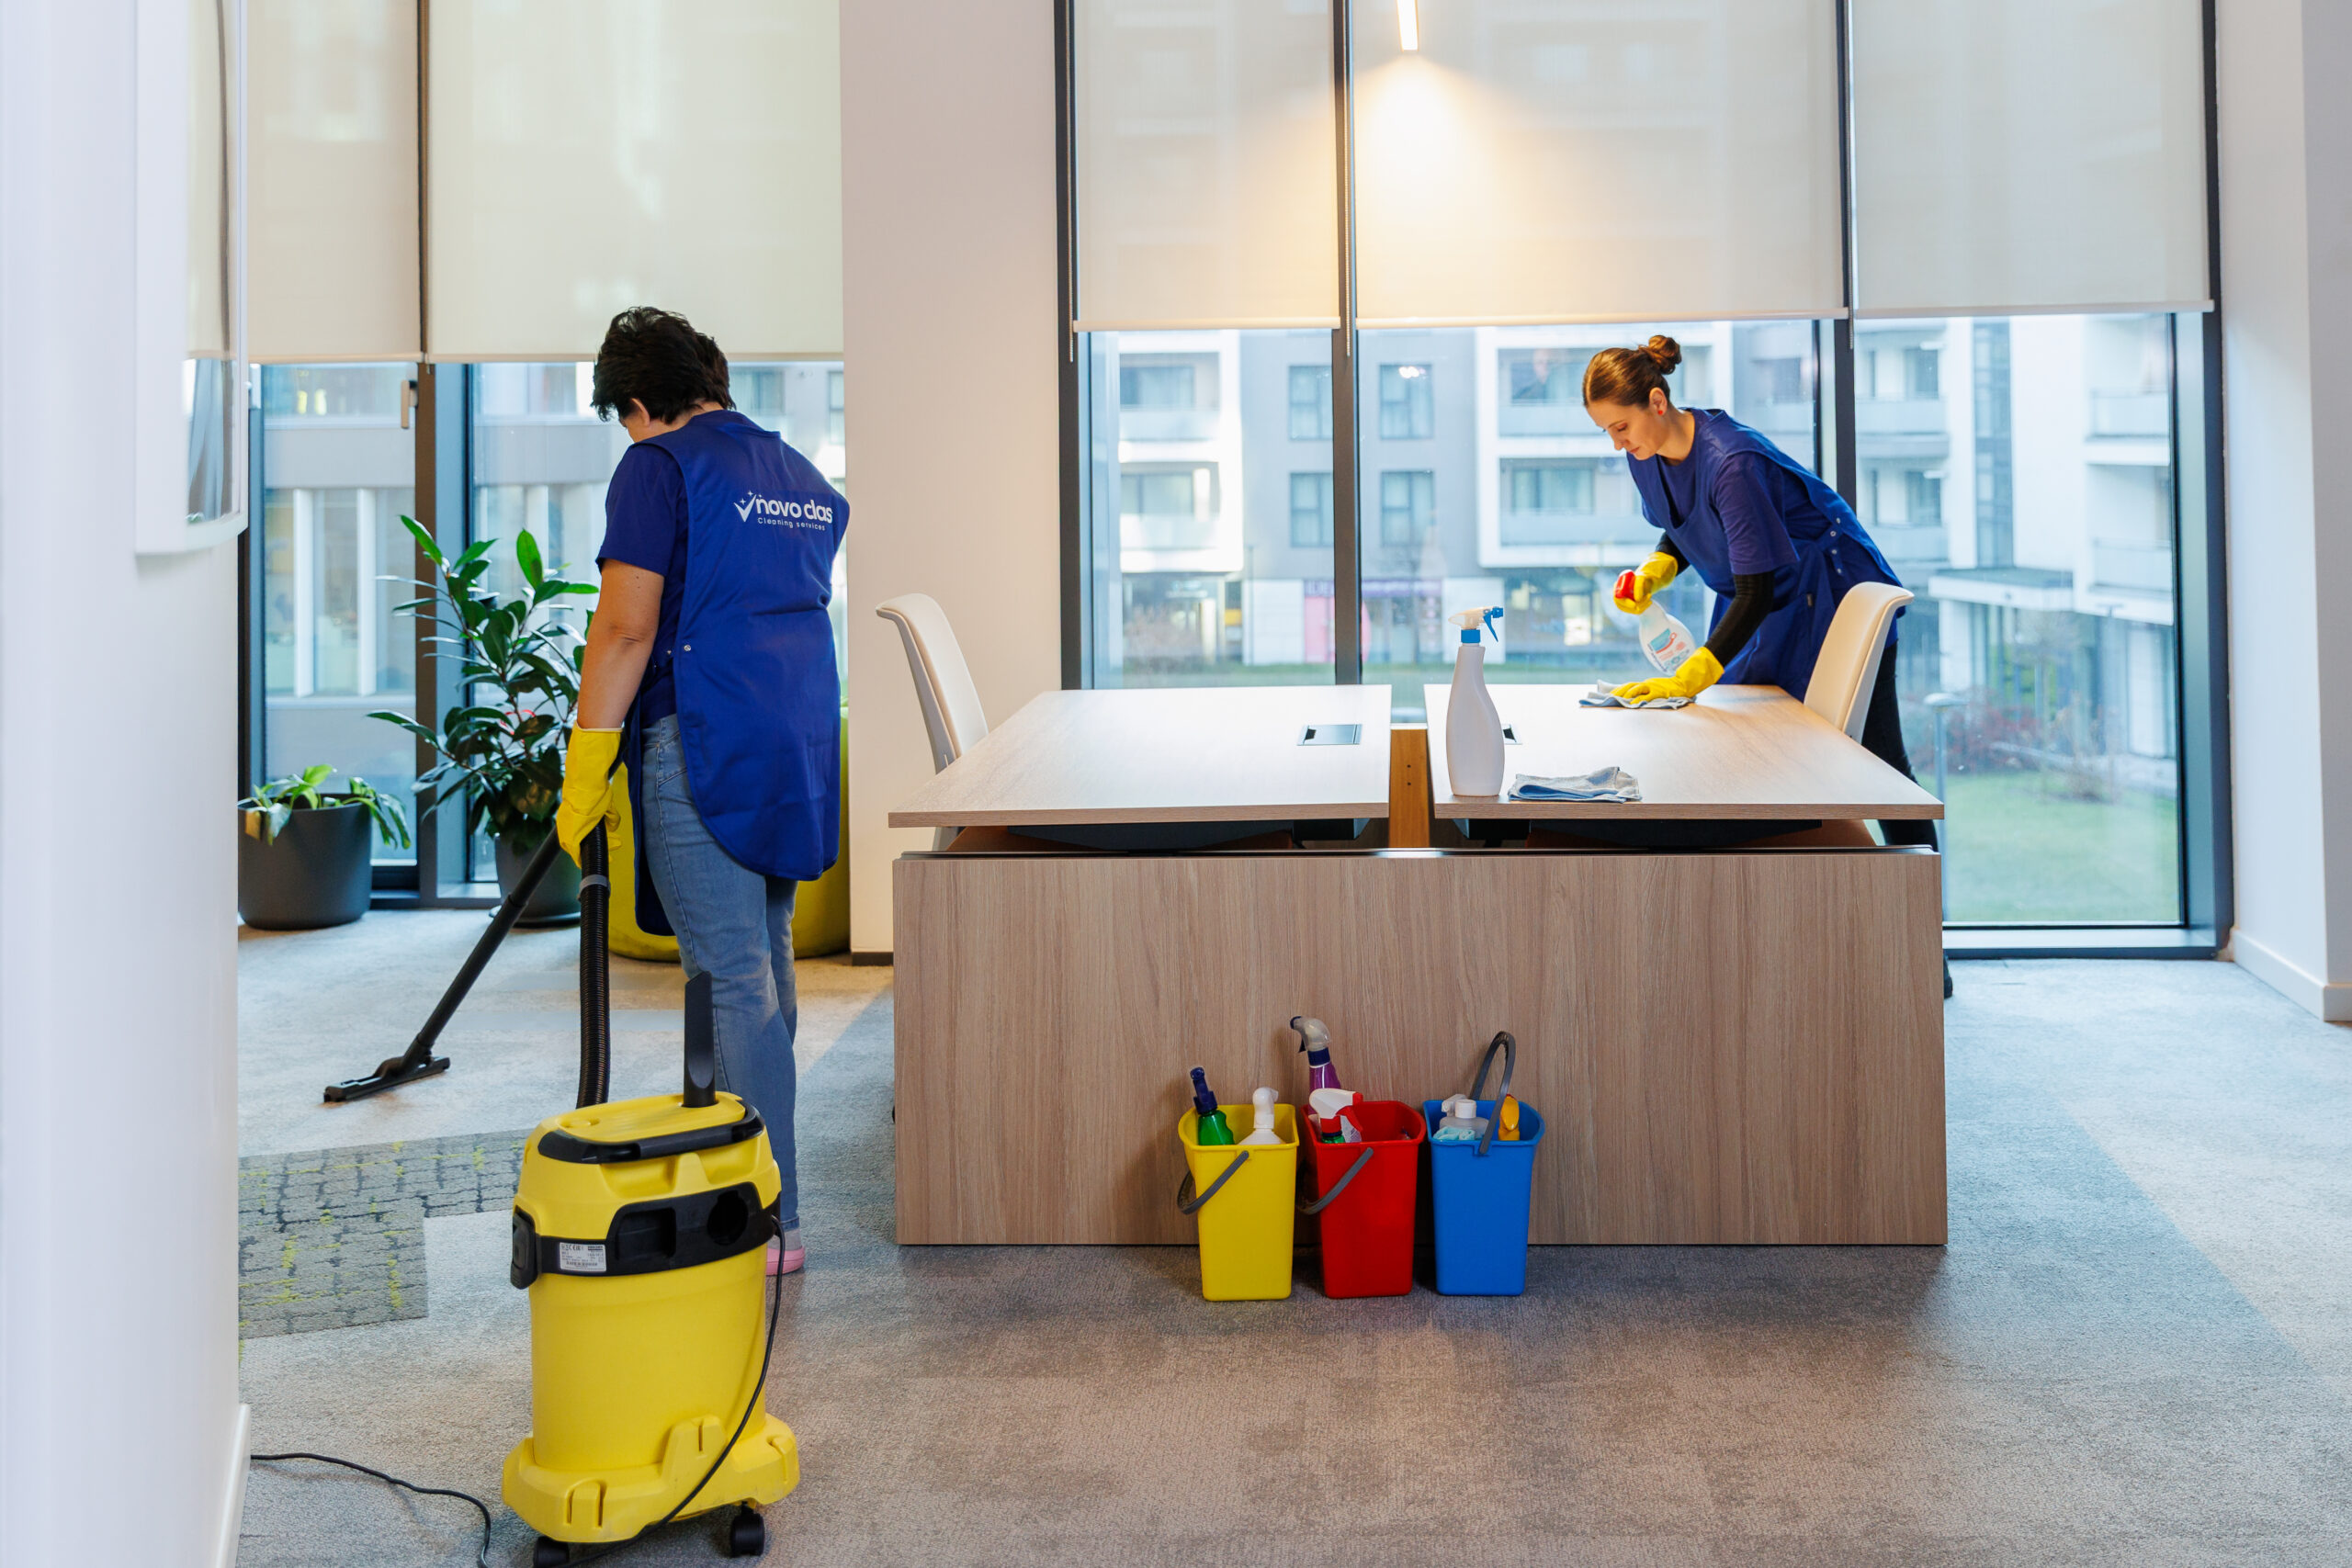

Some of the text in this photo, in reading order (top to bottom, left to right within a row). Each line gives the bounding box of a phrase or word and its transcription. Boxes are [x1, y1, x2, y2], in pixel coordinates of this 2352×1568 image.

[755, 498, 802, 518] novo
[758, 517, 825, 531] Cleaning services
